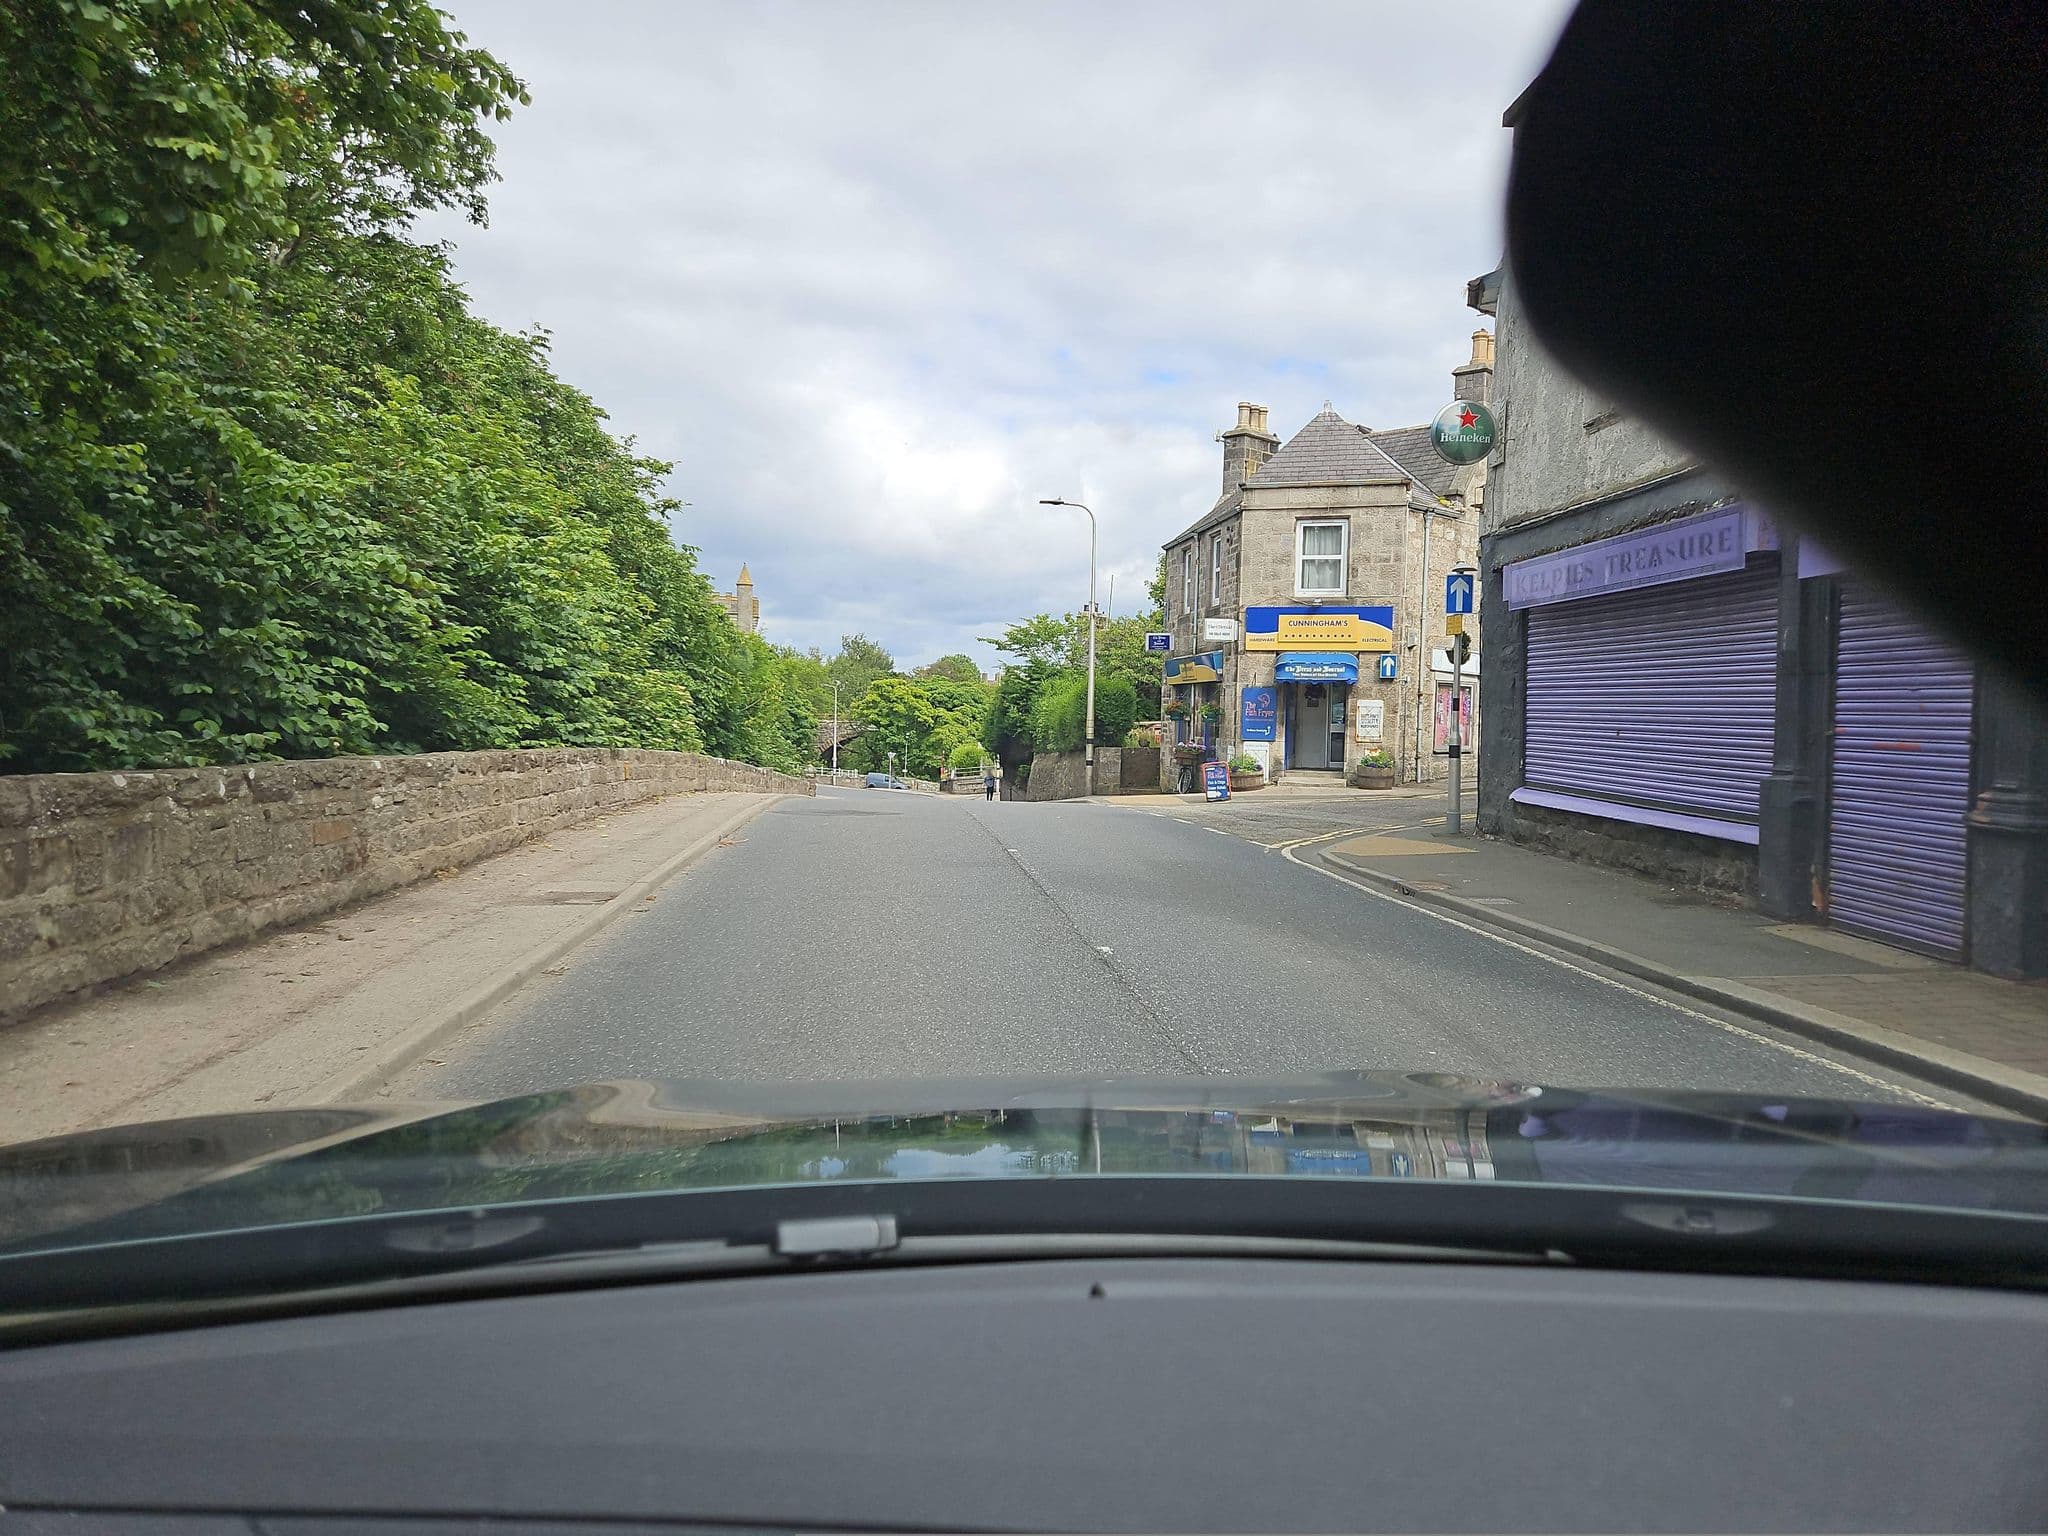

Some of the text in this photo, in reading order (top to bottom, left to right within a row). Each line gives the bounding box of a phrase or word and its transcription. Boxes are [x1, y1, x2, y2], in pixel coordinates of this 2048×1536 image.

[1440, 432, 1491, 443] Heineken
[1605, 526, 1733, 577] TREASURE
[1295, 665, 1312, 673] Press
[1322, 665, 1346, 673] Journal
